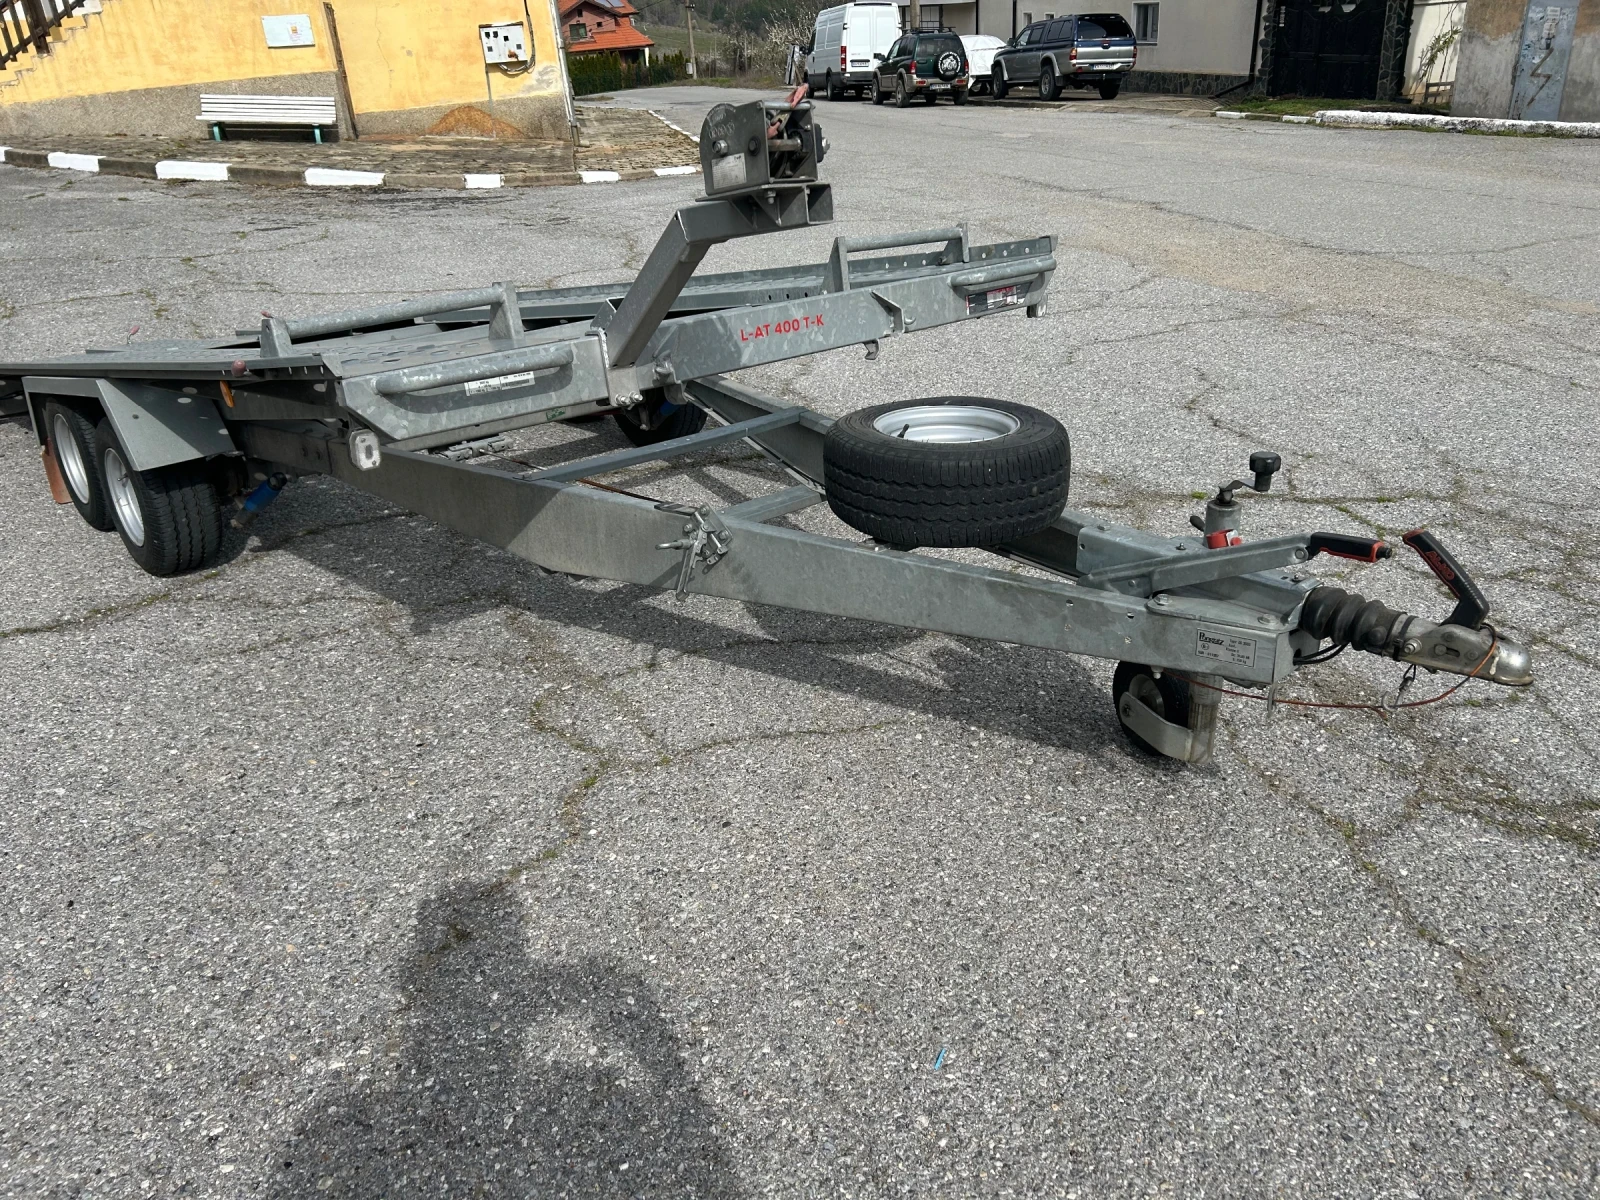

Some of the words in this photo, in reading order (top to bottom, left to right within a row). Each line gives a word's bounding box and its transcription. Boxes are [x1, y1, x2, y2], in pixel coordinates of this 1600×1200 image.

[740, 324, 770, 341] L-AT
[775, 318, 800, 334] 400
[803, 314, 824, 328] T-K
